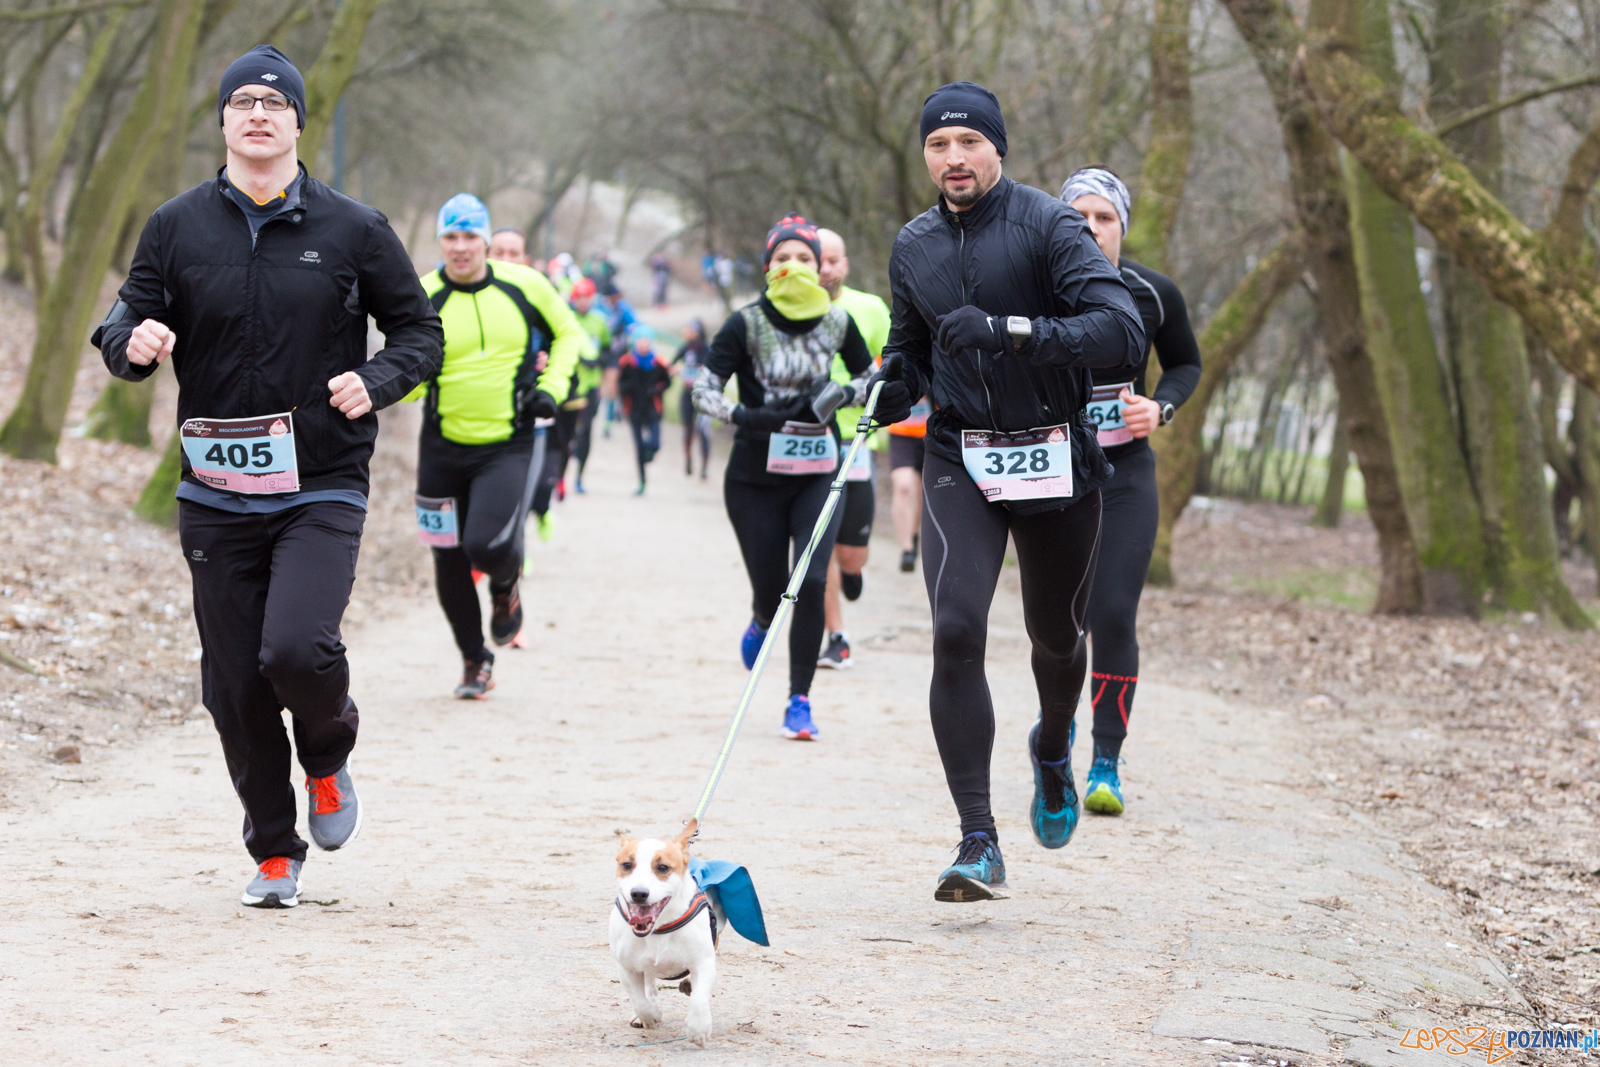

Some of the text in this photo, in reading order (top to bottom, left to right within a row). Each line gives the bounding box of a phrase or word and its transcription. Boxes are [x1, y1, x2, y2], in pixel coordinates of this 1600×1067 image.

[205, 442, 273, 468] 405
[784, 439, 826, 456] 256
[984, 448, 1050, 475] 328
[417, 513, 442, 529] 43
